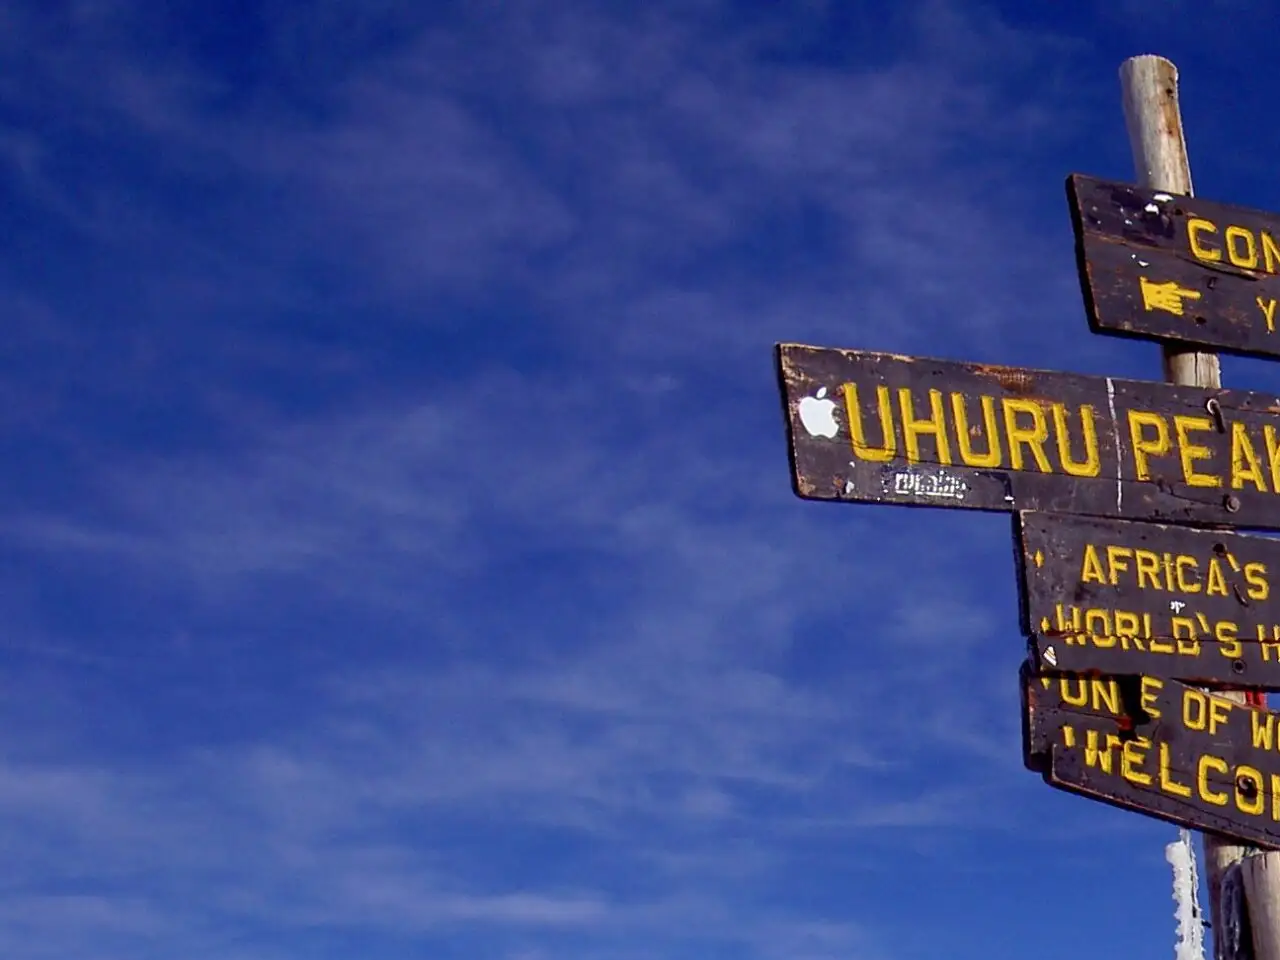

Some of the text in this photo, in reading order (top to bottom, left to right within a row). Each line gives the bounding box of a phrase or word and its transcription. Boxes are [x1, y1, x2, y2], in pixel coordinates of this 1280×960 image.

[842, 383, 1100, 477] UHURU
[1081, 544, 1269, 600] AFRICA'S
[1056, 604, 1242, 658] WORLD'S
[1183, 690, 1233, 734] OF
